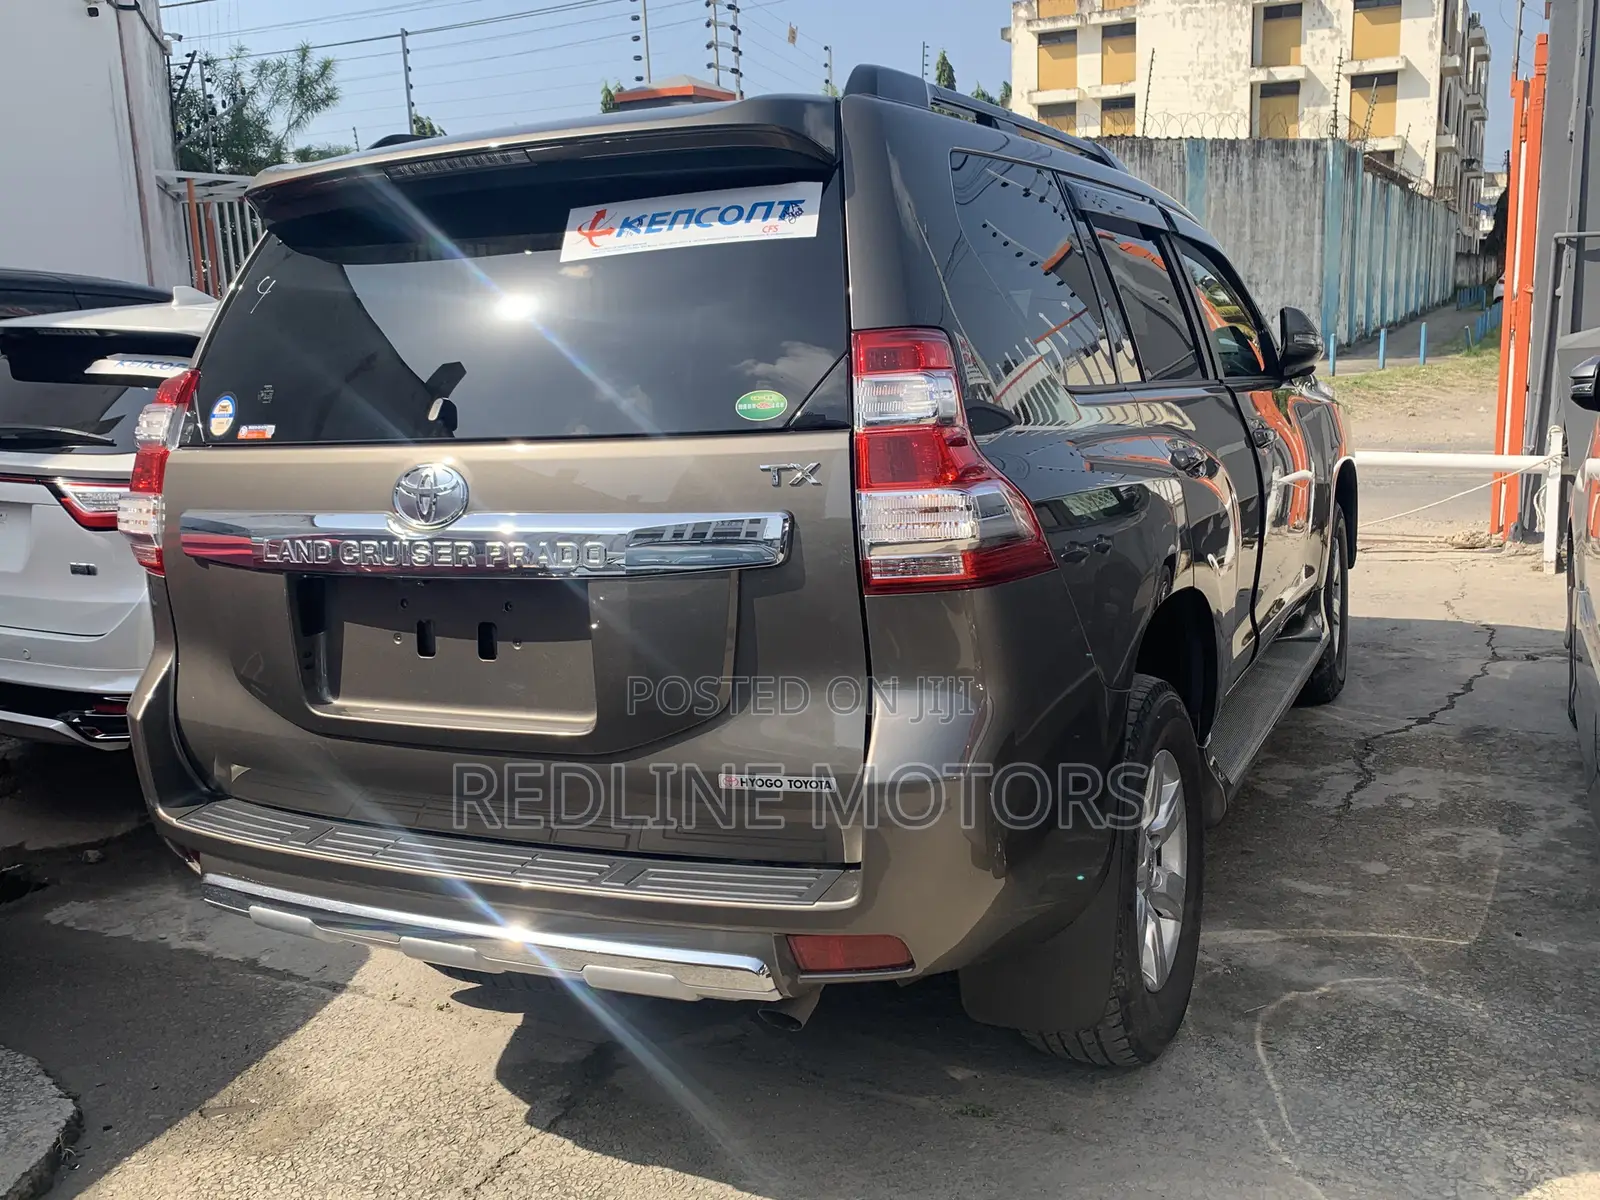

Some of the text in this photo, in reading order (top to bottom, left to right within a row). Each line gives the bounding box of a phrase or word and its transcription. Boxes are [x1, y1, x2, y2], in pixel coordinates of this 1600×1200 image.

[762, 224, 779, 233] CFS
[759, 462, 822, 487] TX
[262, 540, 608, 569] LAND CRUISER PRADO
[740, 777, 832, 790] HYOGO TOYOTA
